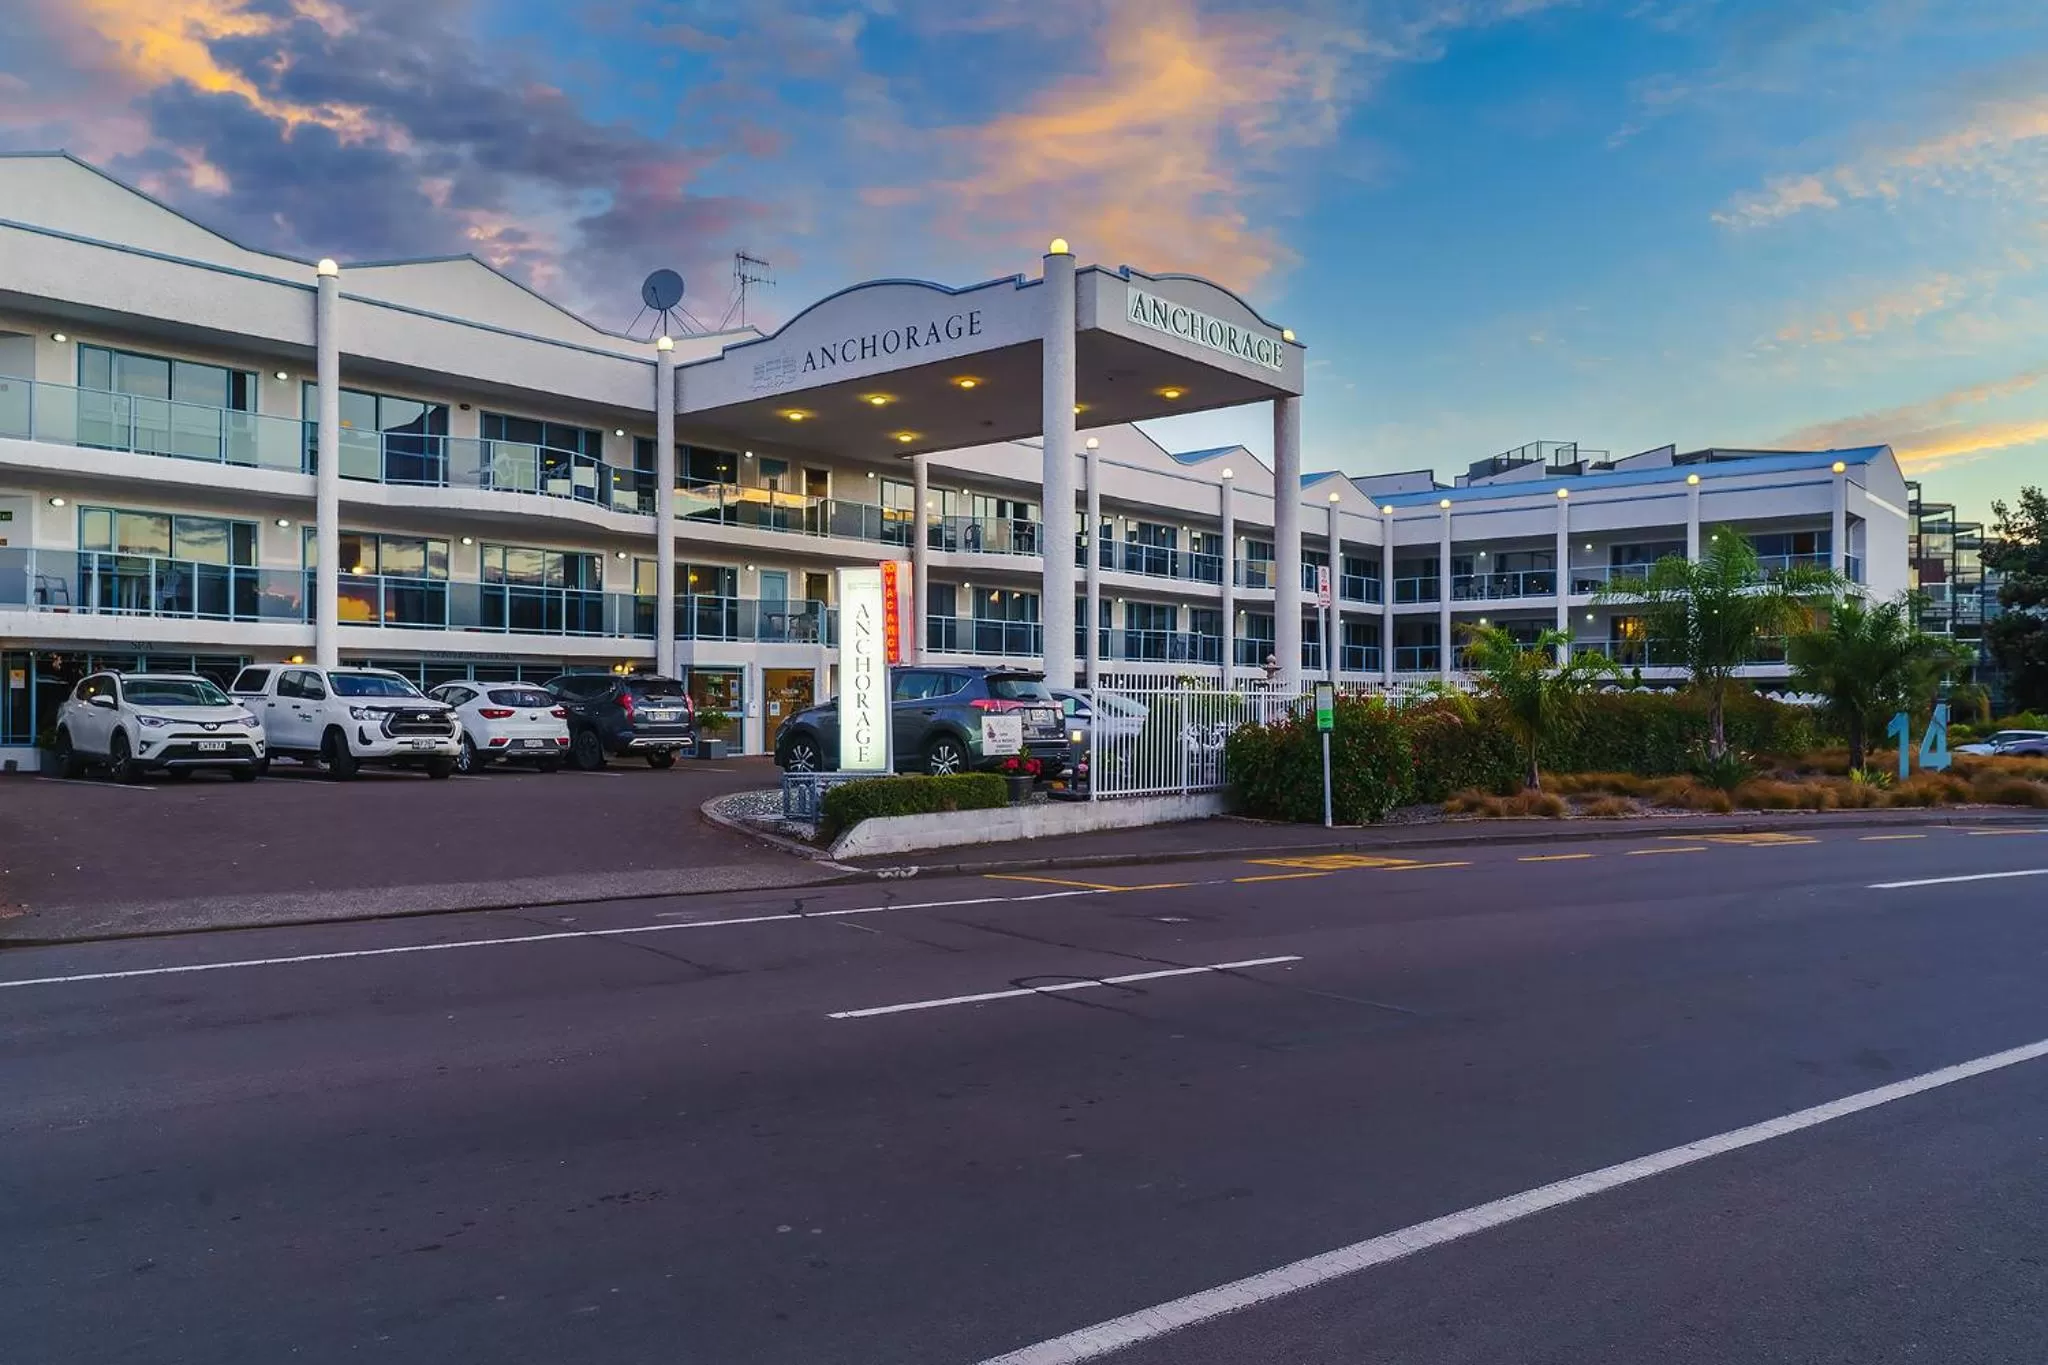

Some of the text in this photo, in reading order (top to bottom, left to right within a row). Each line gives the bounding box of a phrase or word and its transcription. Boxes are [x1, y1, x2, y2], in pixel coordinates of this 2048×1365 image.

[802, 310, 983, 374] ANCHORAGE
[1132, 292, 1284, 368] ANCHORAGE
[885, 575, 897, 661] VACANCY
[855, 603, 871, 763] ANCHORAGE
[1887, 704, 1952, 779] 14
